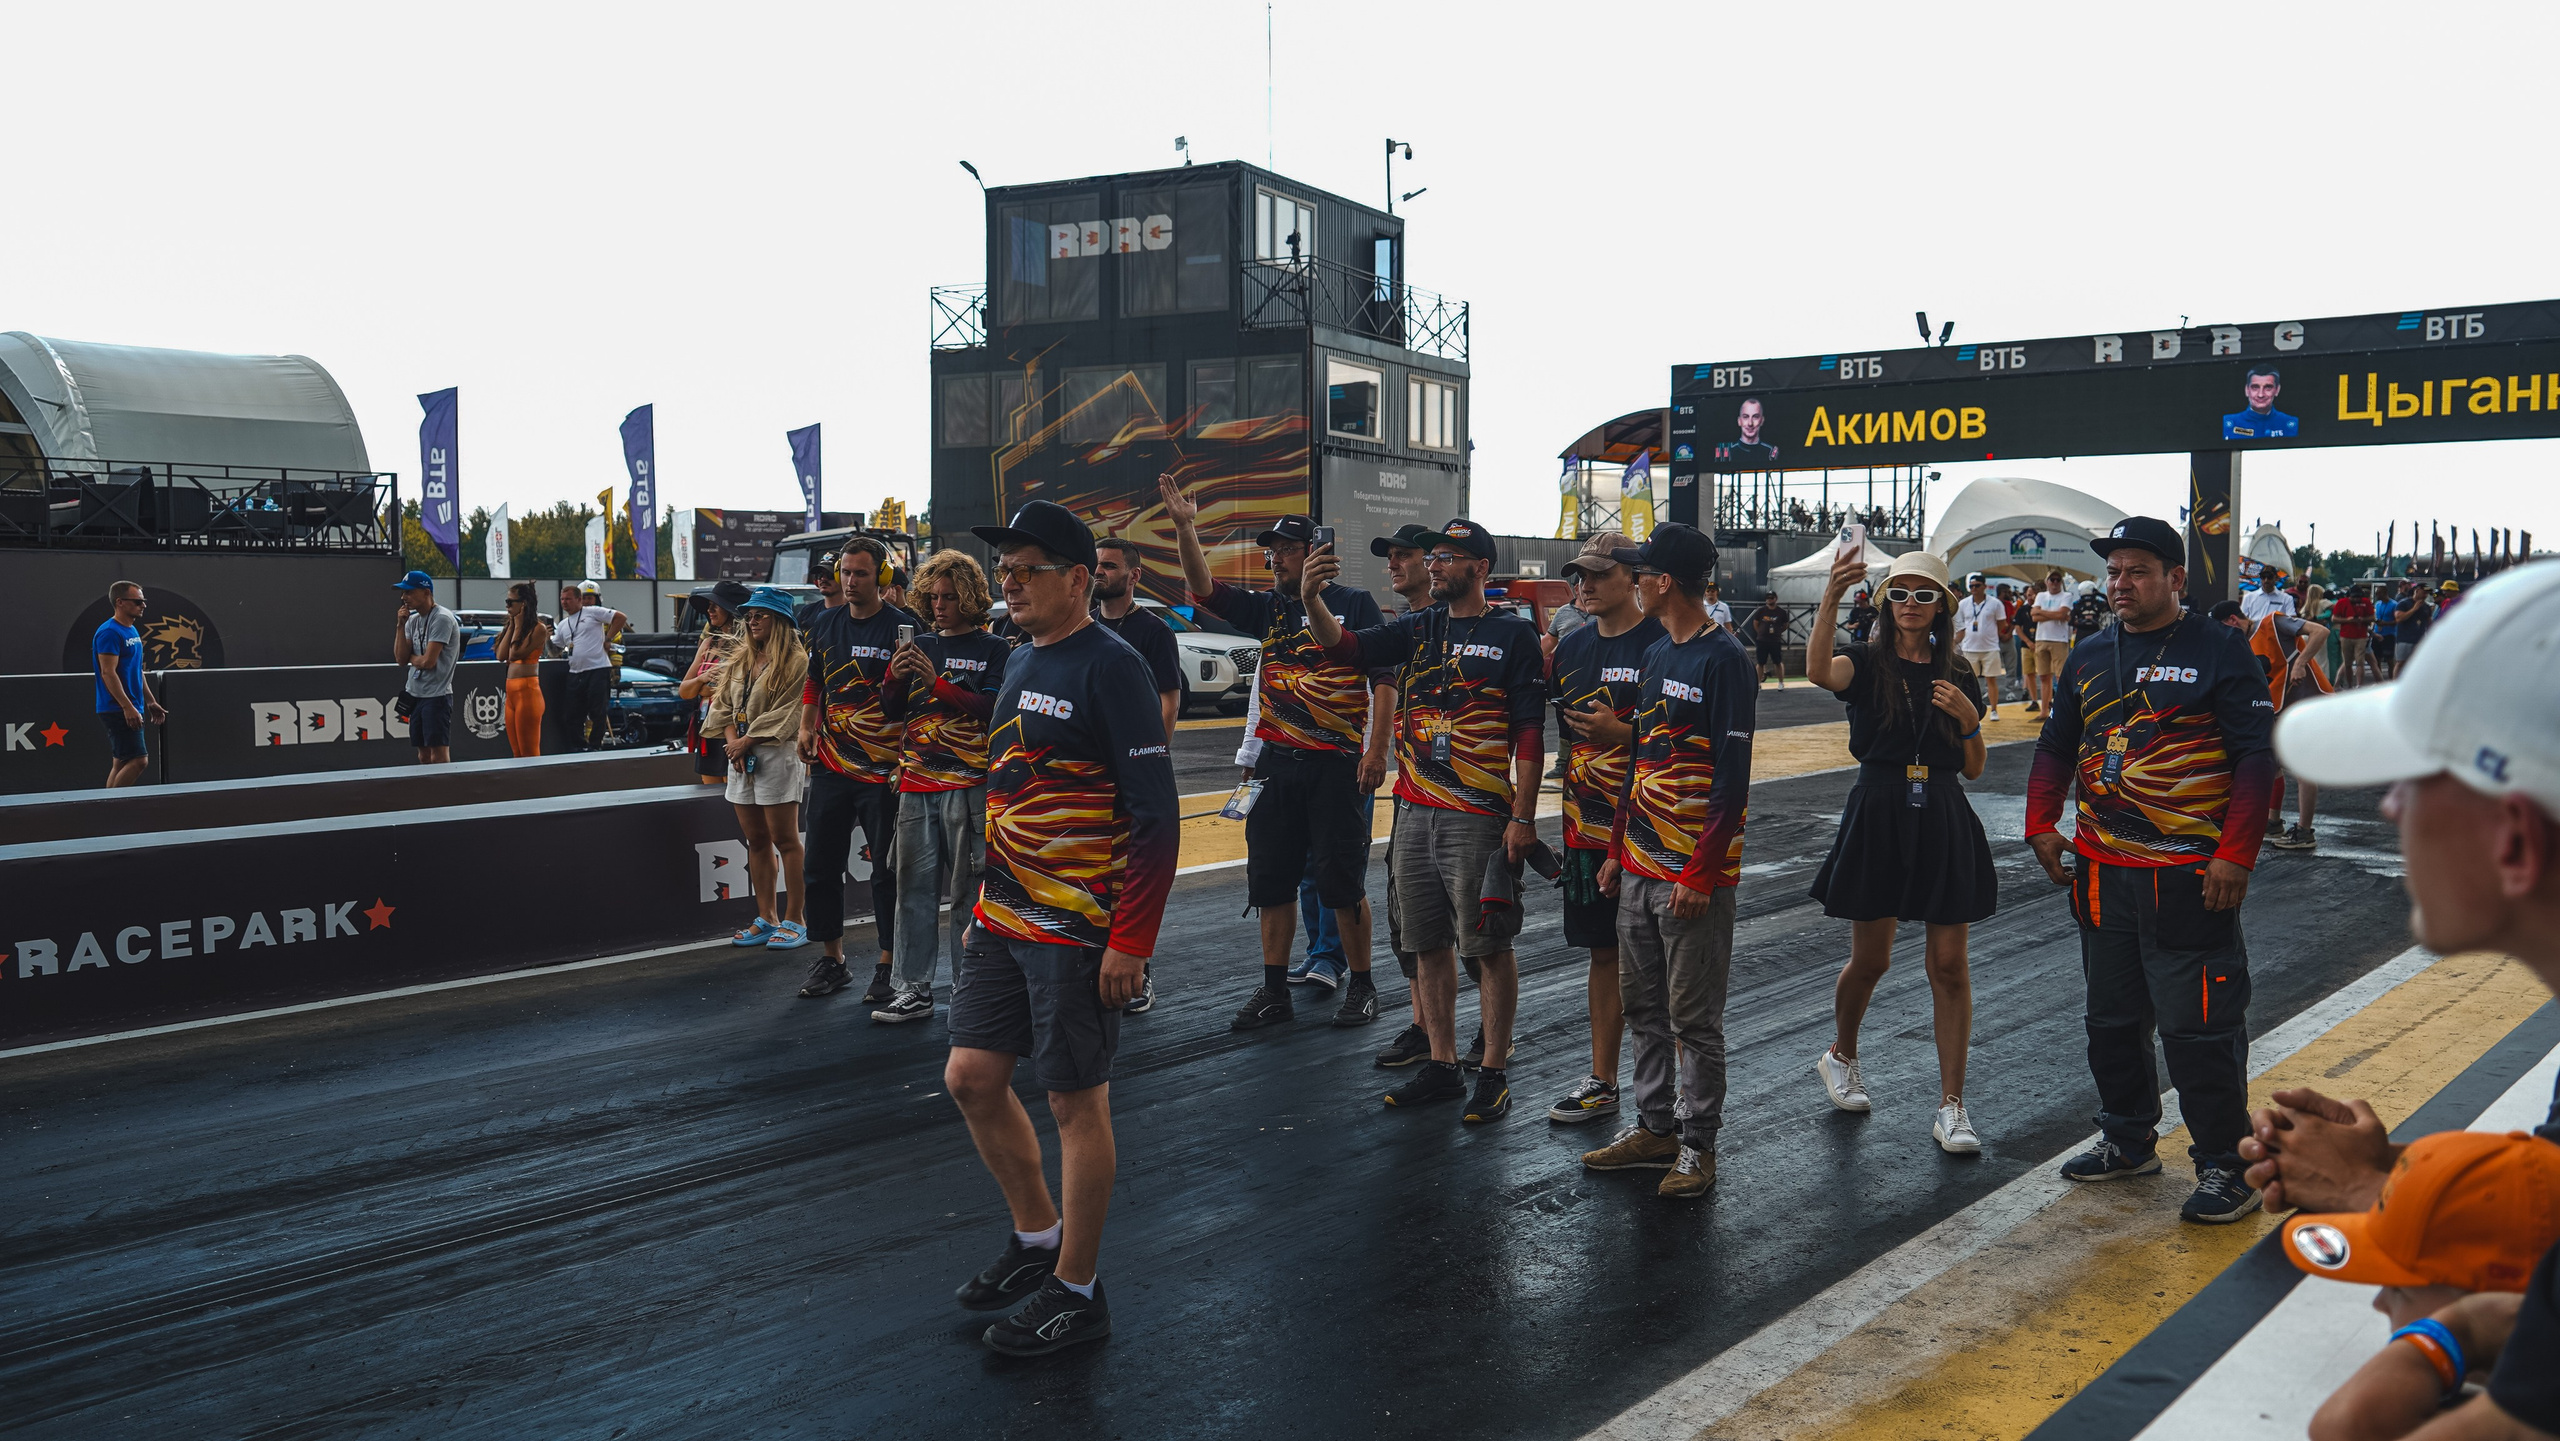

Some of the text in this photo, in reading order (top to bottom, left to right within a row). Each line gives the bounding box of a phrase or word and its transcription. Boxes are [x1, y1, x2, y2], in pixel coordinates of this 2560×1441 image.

[1049, 214, 1173, 260] RDRC
[2425, 313, 2485, 342] ВТБ
[1840, 356, 1883, 380] ВТБ
[1980, 346, 2026, 371] ВТБ
[1713, 366, 1753, 389] ВТБ
[1680, 406, 1694, 415] ВТБ
[1804, 406, 1987, 447] Акимов
[1378, 471, 1407, 490] RDRC
[851, 645, 891, 660] RDRC
[1452, 643, 1504, 661] RDRC
[944, 657, 987, 672] RDRC
[2135, 666, 2198, 684] RDRC
[1661, 678, 1703, 703] RDRC
[1017, 690, 1074, 720] RDRC
[15, 900, 360, 979] RACEPARK
